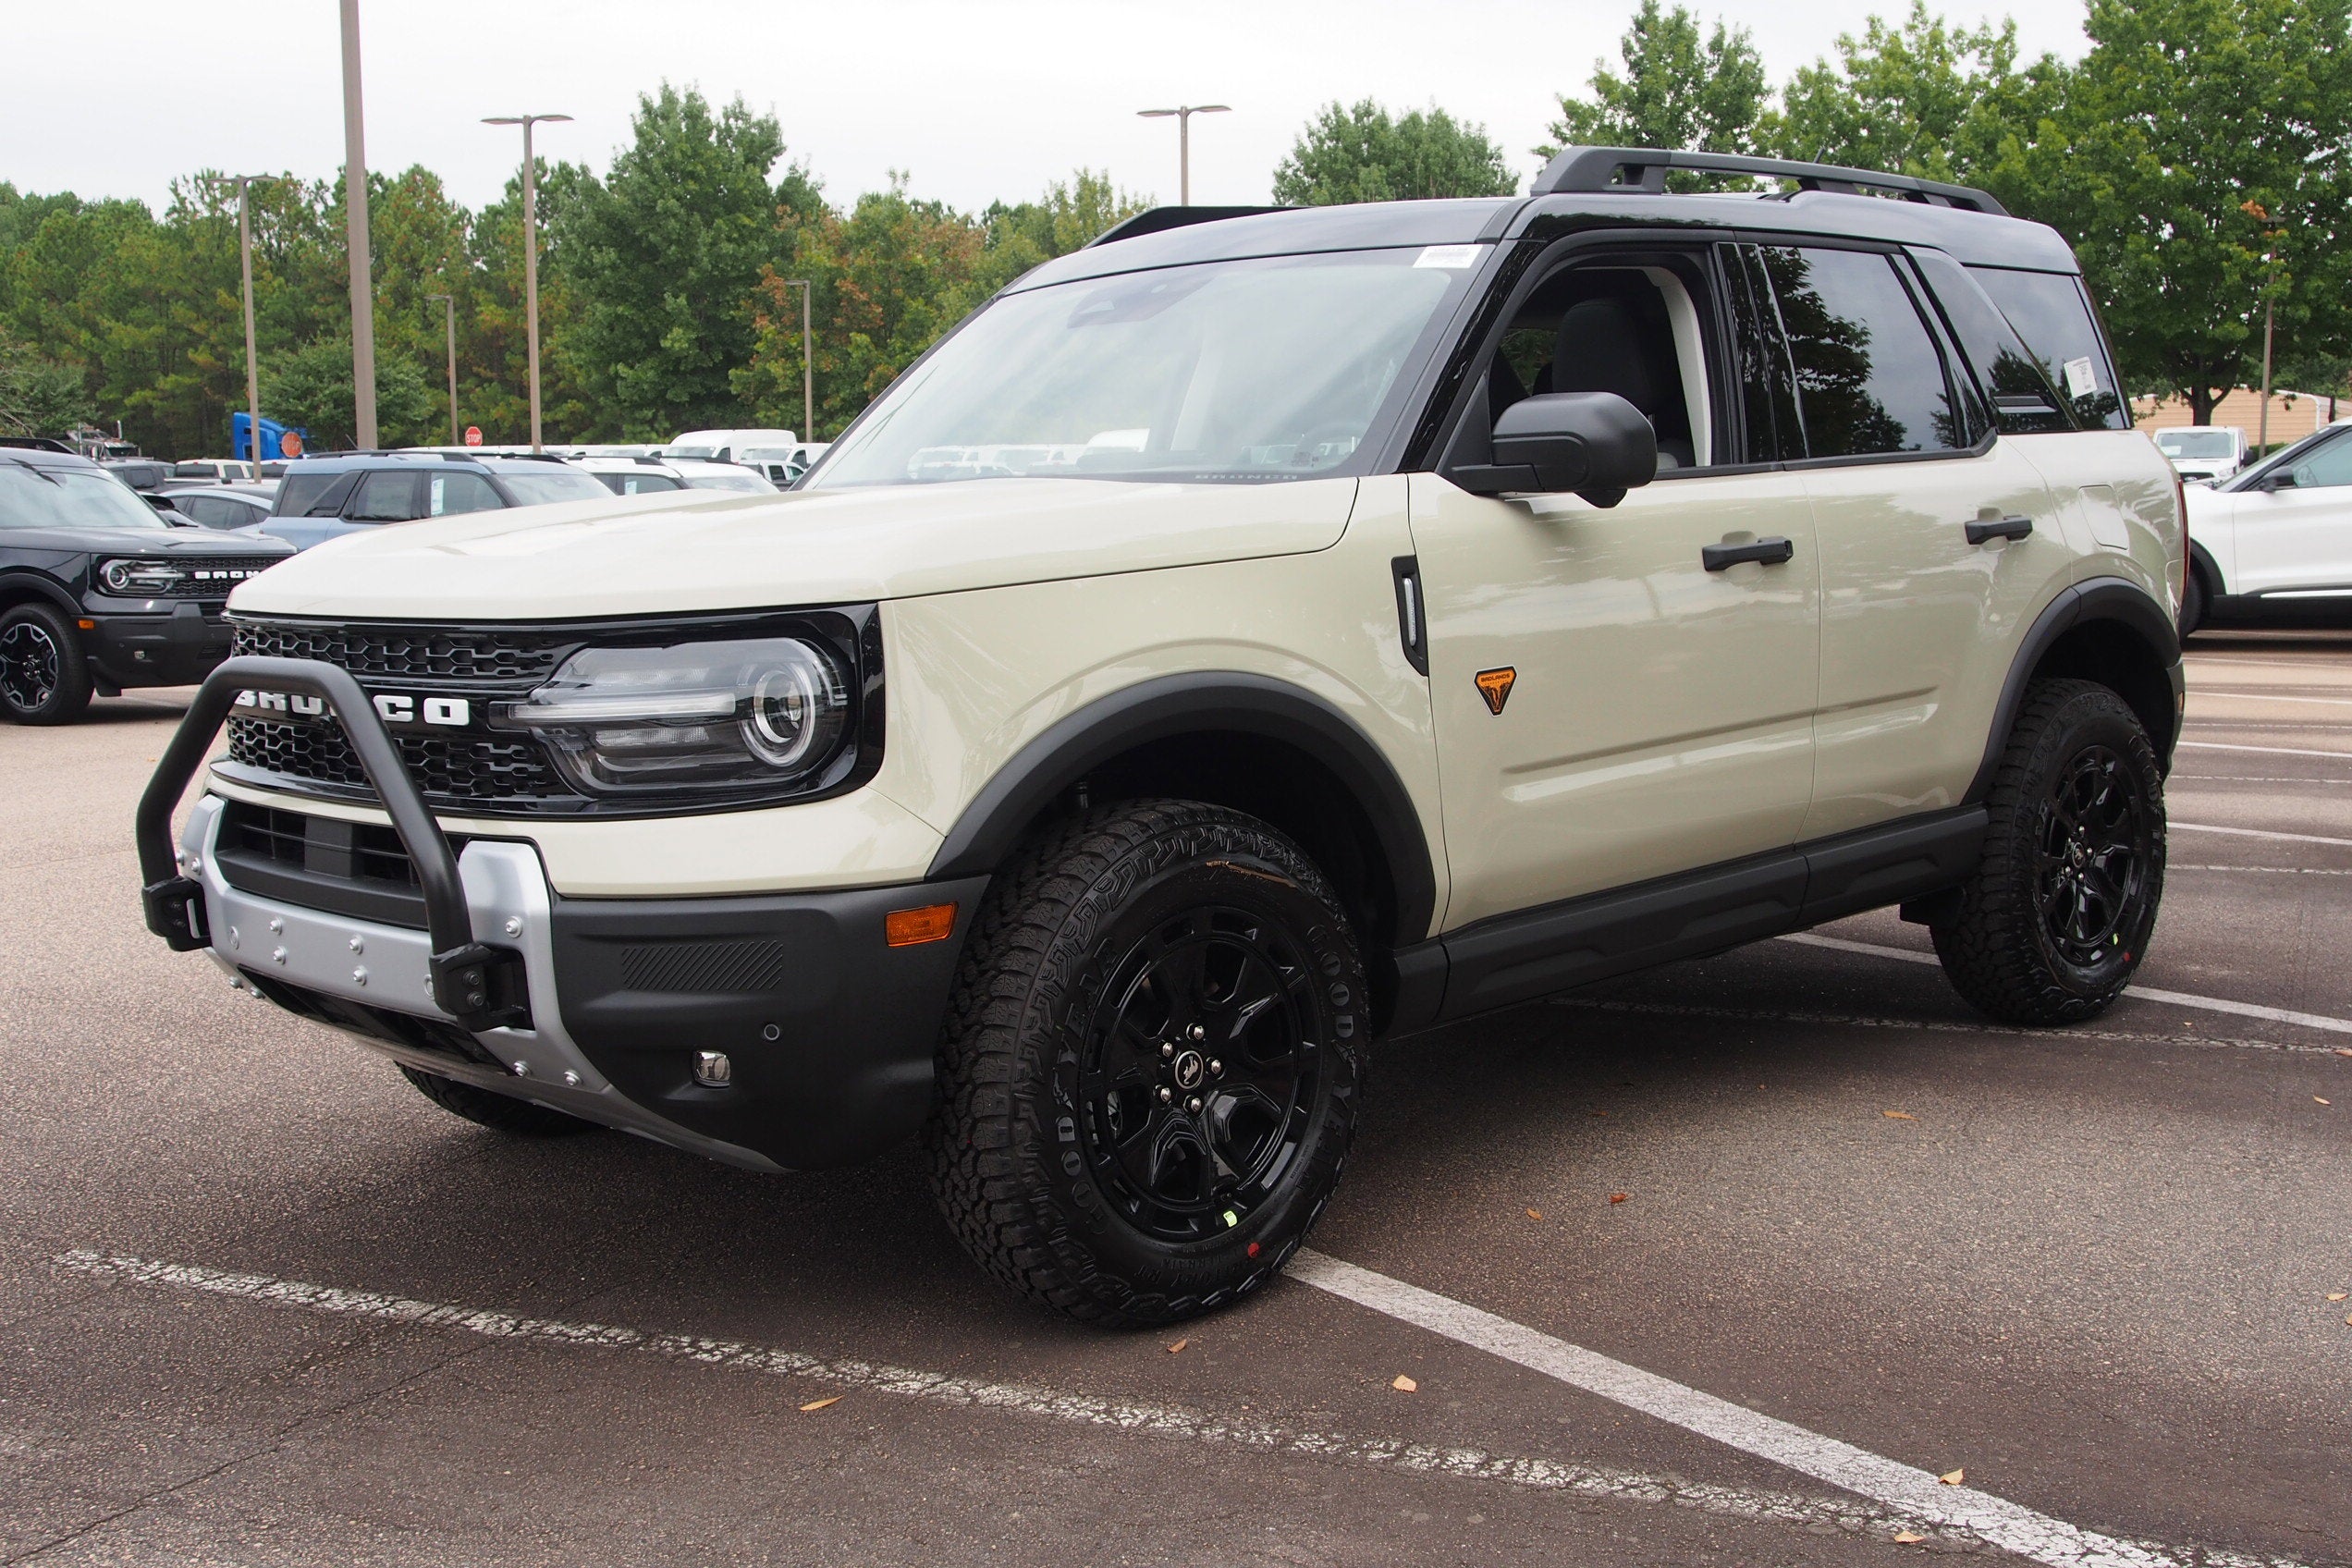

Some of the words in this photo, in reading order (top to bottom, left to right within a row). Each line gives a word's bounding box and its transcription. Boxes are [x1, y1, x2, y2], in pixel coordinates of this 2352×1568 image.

[467, 434, 481, 443] STOP
[1480, 673, 1511, 682] BADLANDS
[234, 690, 469, 726] BROCO
